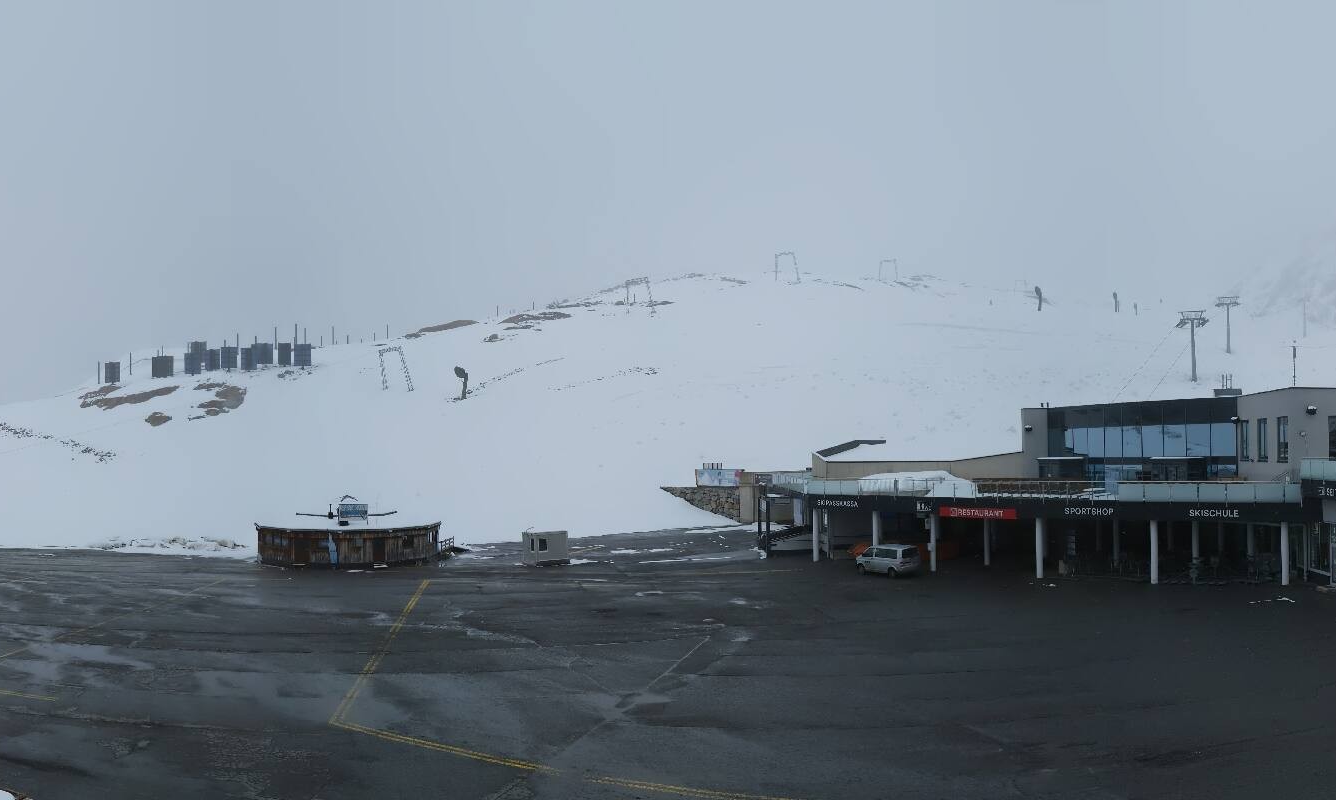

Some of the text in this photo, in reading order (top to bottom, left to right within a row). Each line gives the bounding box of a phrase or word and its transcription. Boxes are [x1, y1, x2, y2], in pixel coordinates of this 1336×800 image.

[958, 508, 1004, 518] RESTAURANT
[1064, 507, 1114, 516] SPORTSHOP
[1189, 509, 1239, 518] SKISCHULE
